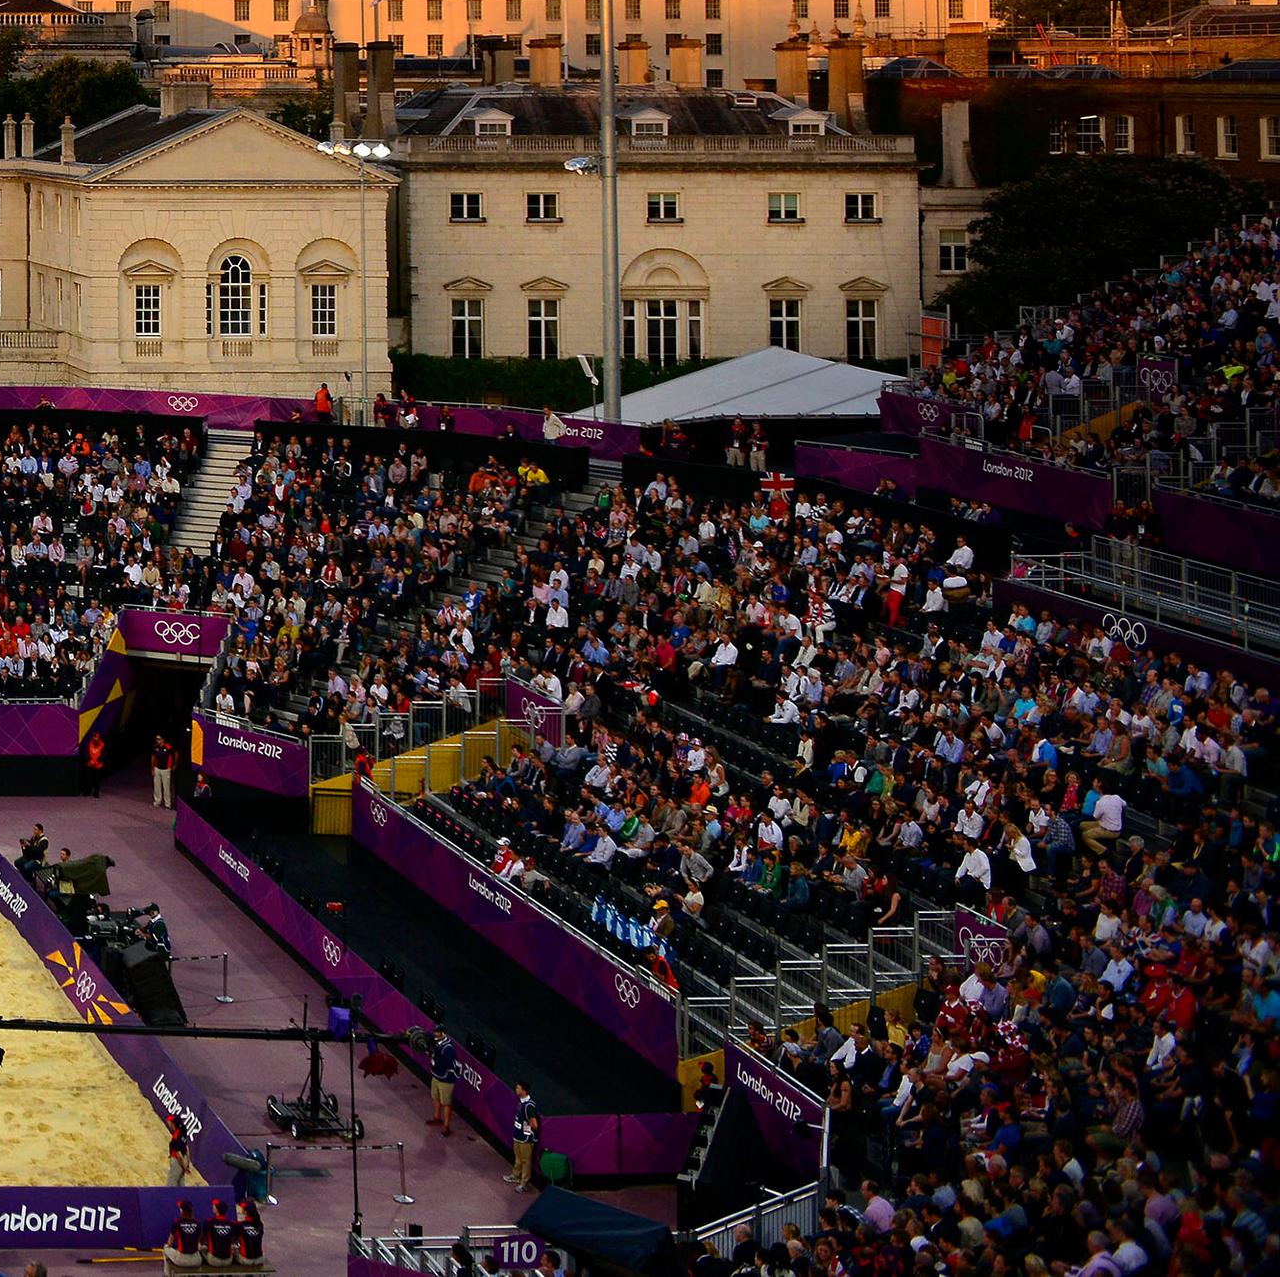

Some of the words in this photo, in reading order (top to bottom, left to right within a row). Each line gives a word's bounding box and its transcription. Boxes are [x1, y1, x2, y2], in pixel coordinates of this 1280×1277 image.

[580, 426, 604, 440] 2012
[982, 459, 1013, 478] London
[1014, 466, 1034, 482] 2012
[217, 731, 256, 753] London
[257, 741, 283, 760] 2012
[218, 844, 237, 872] London
[237, 860, 250, 882] 2012
[10, 892, 29, 919] 2012
[468, 872, 494, 903] London
[494, 891, 512, 915] 2012
[463, 1062, 483, 1092] 2012
[152, 1073, 183, 1115] London
[736, 1062, 775, 1105] London
[775, 1091, 802, 1122] 2012
[64, 1205, 121, 1232] 2012
[500, 1240, 538, 1264] 110
